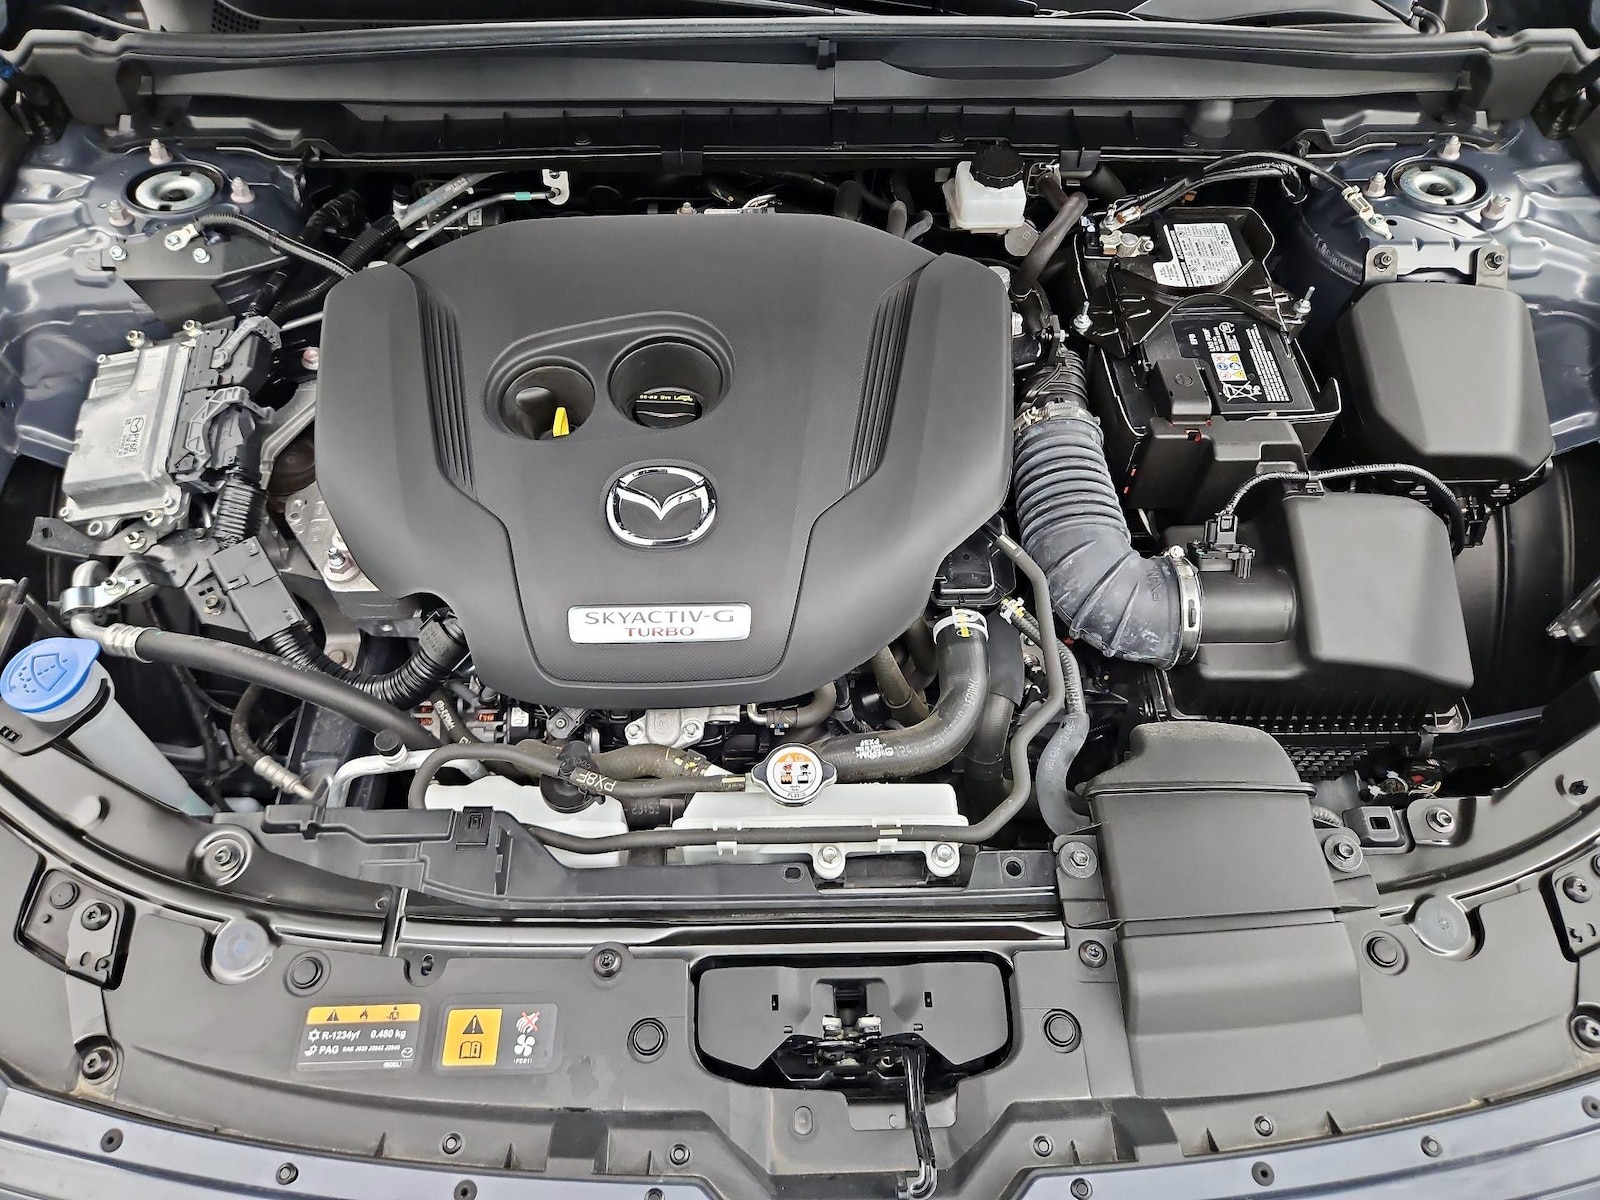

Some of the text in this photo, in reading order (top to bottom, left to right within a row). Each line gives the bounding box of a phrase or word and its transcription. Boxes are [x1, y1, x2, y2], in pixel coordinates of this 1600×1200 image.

[584, 610, 735, 625] SKYACTIV-G
[624, 627, 695, 637] TURBO
[575, 771, 617, 793] PX8F
[321, 1030, 361, 1041] R-1234yf
[395, 1029, 407, 1040] kg
[319, 1045, 340, 1055] PAG
